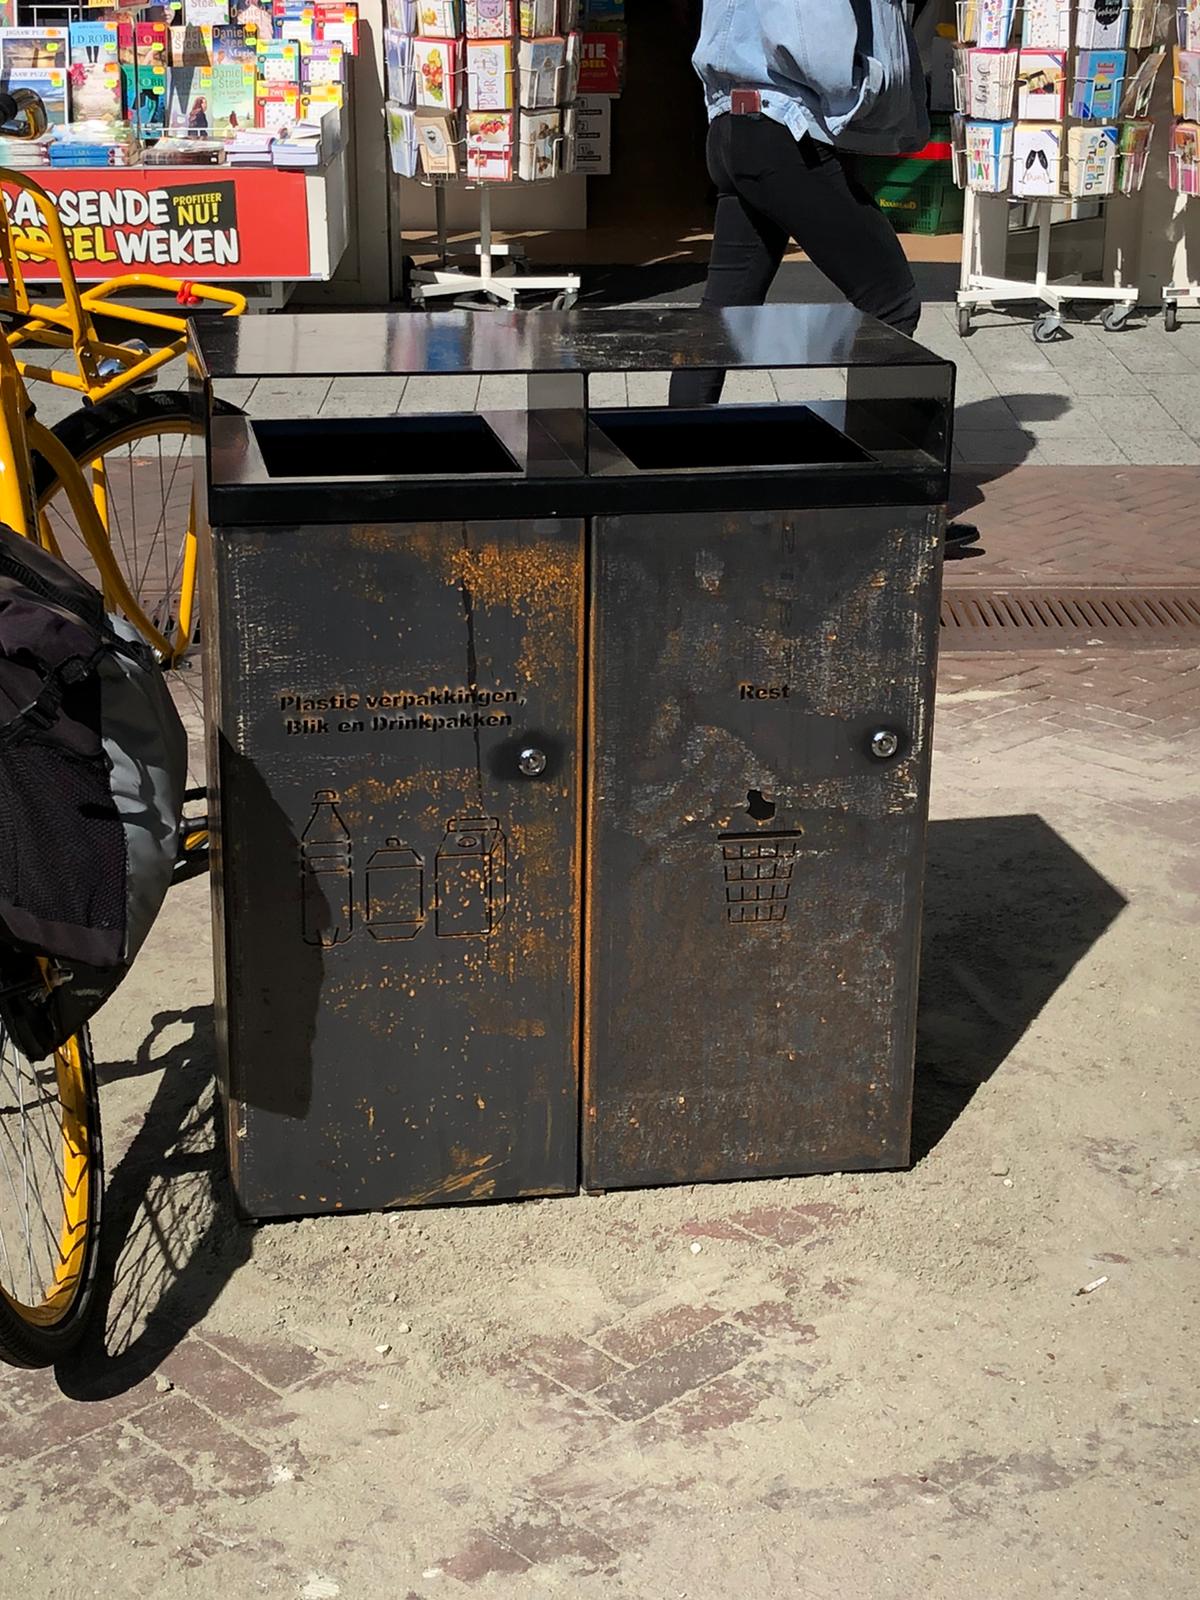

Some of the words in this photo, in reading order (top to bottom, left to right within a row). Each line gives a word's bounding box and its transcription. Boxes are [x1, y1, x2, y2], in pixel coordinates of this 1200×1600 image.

[88, 34, 116, 44] ROBB
[970, 162, 990, 180] DAY
[172, 192, 222, 206] PROFITEER
[177, 202, 219, 226] NU!
[740, 684, 790, 700] Rest
[279, 694, 359, 712] Plastic
[286, 719, 329, 735] Blik
[337, 721, 365, 733] en
[372, 713, 513, 732] Drinkpakken
